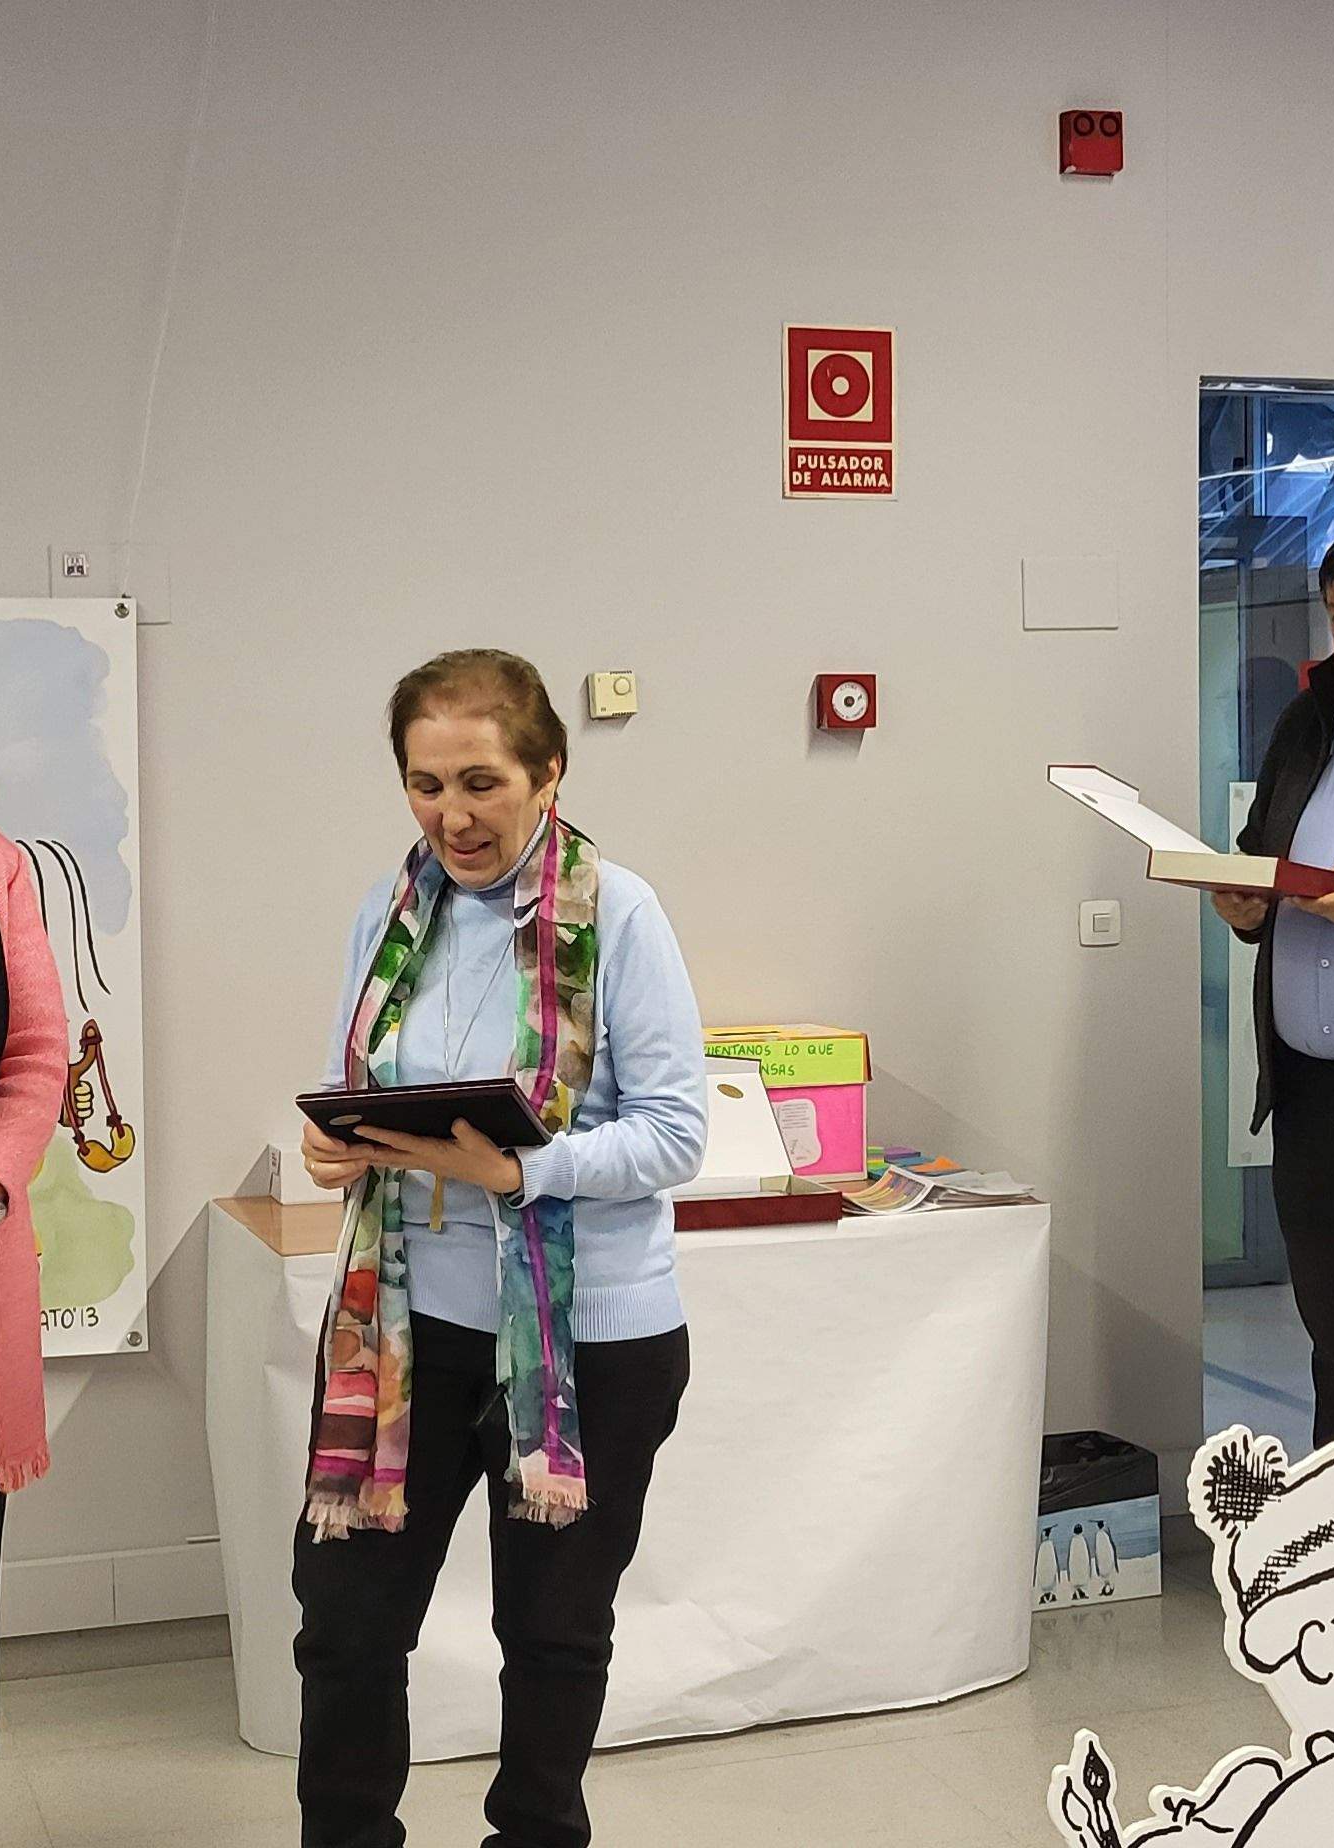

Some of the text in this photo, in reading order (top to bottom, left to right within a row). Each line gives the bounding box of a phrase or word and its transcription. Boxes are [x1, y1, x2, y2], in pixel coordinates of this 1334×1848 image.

[797, 454, 884, 471] PULSADOR
[792, 471, 889, 487] DE ALARMA
[784, 1044, 799, 1056] LO
[808, 1043, 834, 1056] QUE
[761, 1063, 795, 1076] NSAS
[40, 1306, 99, 1331] ATO'13
